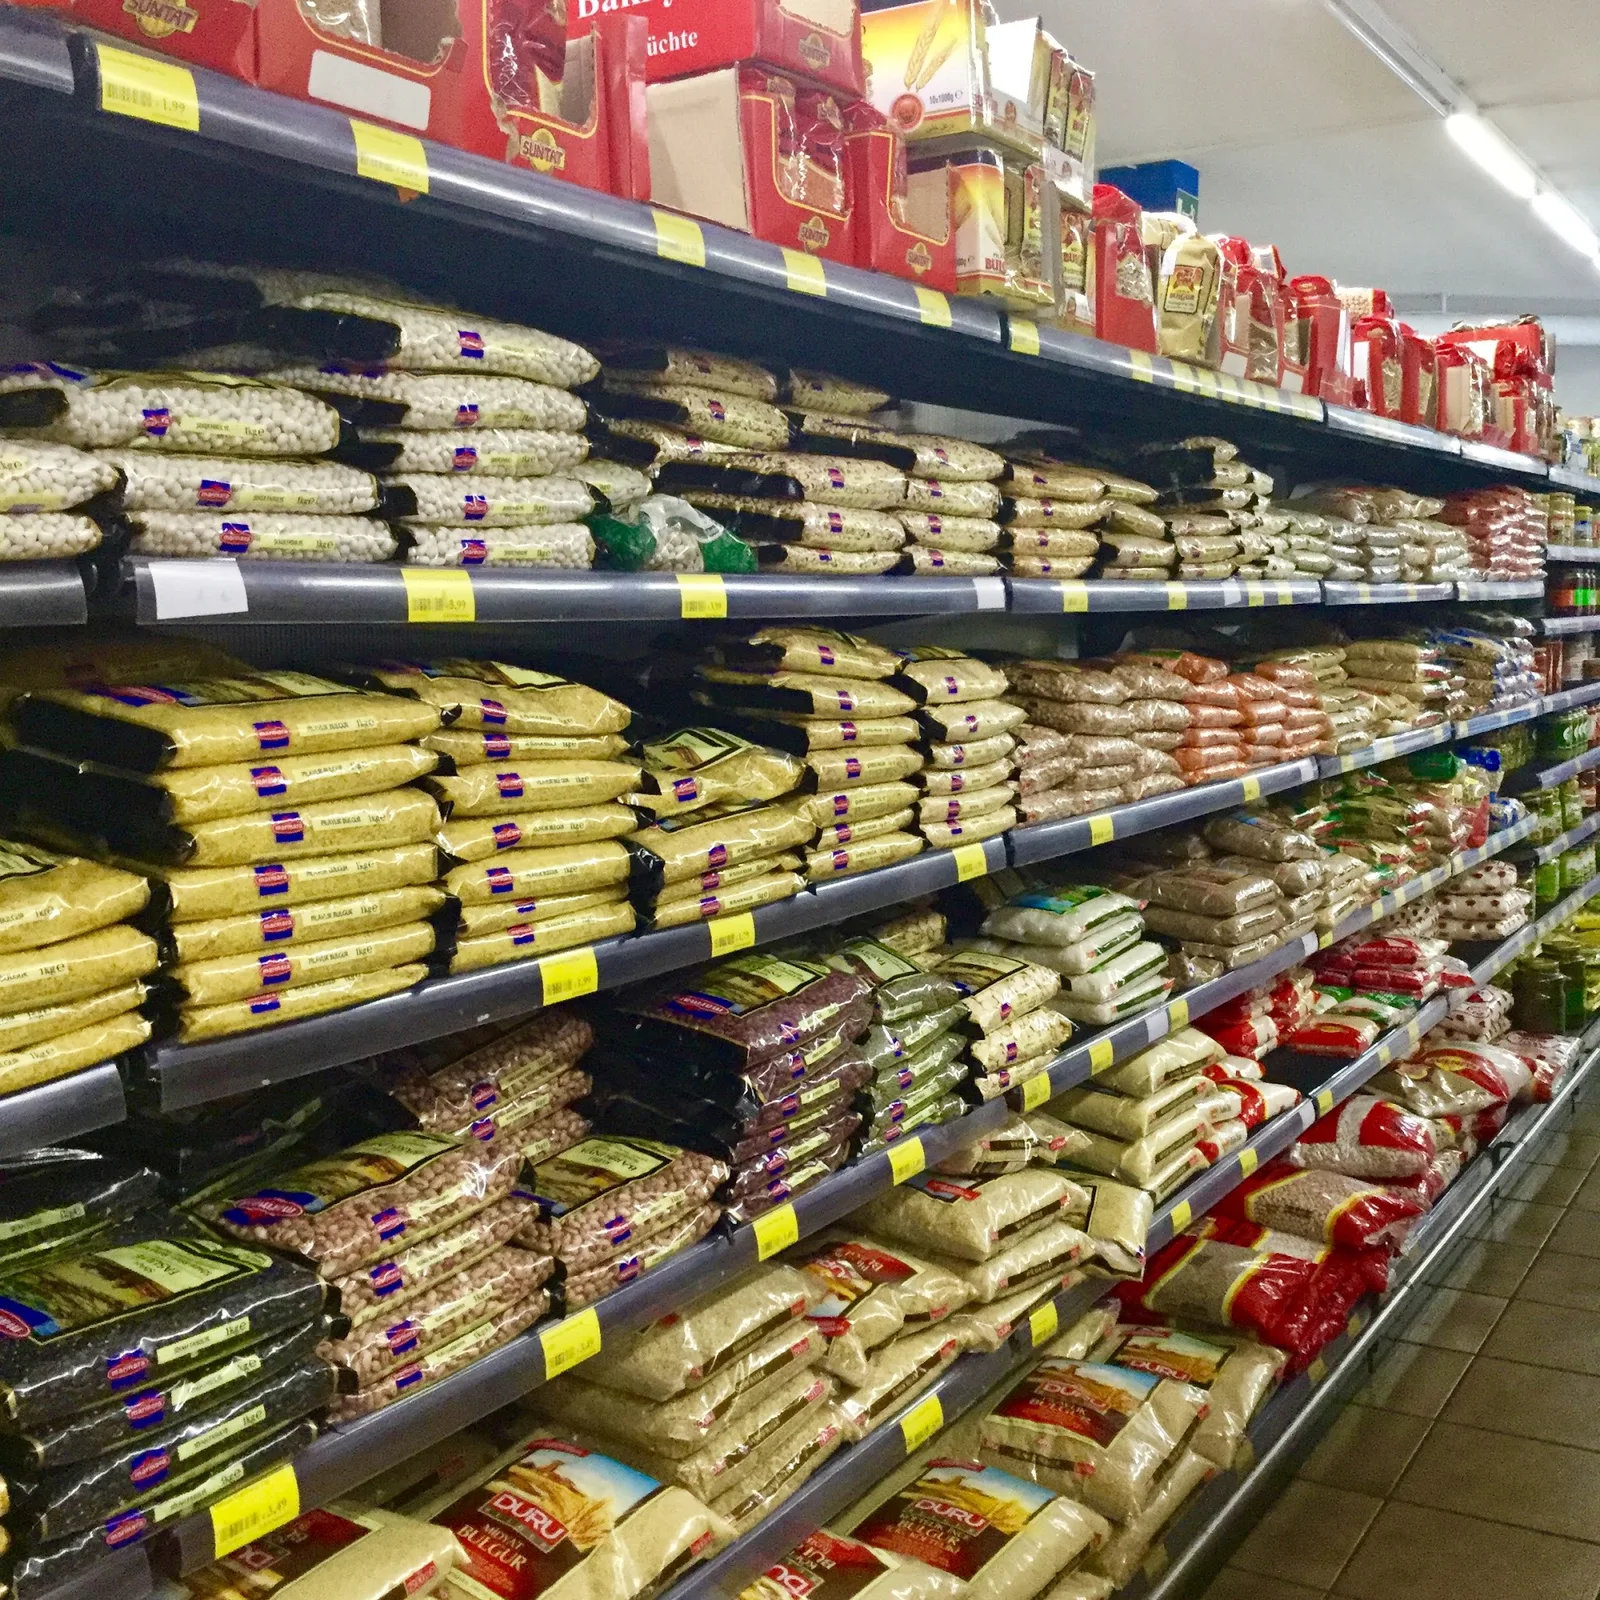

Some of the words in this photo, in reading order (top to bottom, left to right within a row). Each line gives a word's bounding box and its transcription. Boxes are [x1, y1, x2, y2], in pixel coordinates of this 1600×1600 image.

[647, 31, 698, 56] üchte
[522, 141, 563, 165] SUNTAT
[493, 1493, 566, 1540] DURU
[914, 1499, 986, 1528] DURU
[456, 1524, 528, 1572] BULGUR
[770, 1564, 810, 1595] DU
